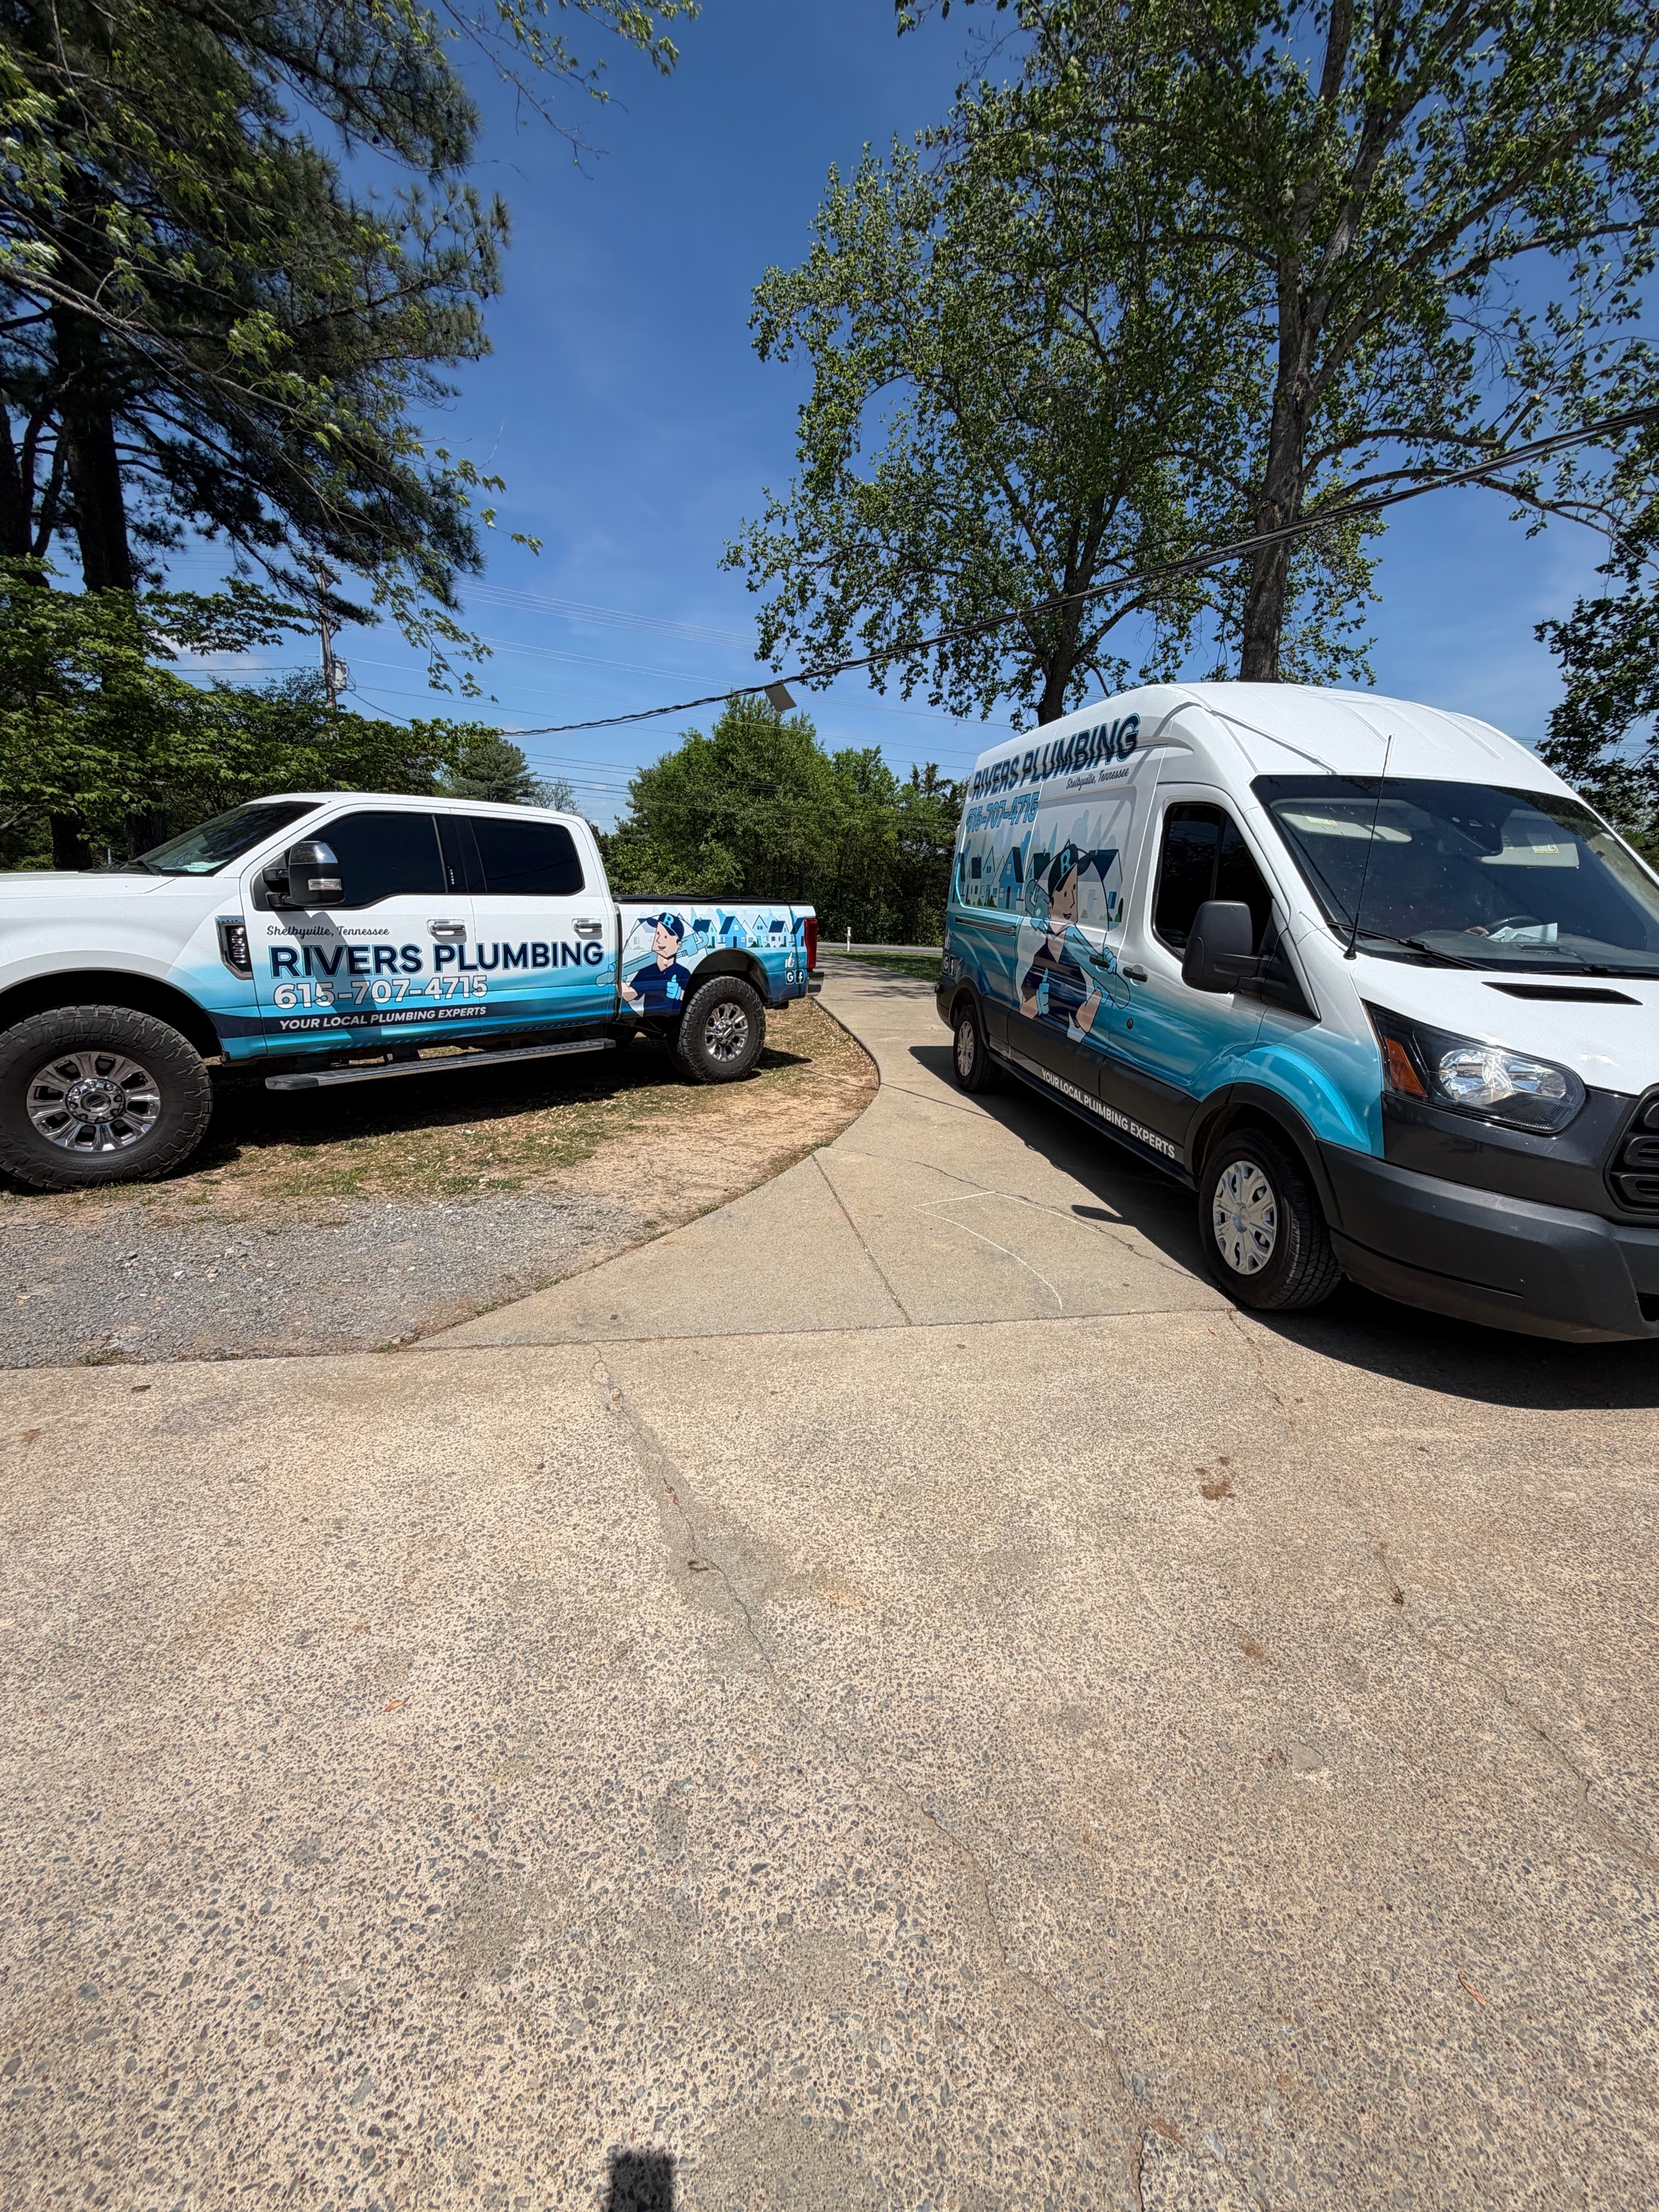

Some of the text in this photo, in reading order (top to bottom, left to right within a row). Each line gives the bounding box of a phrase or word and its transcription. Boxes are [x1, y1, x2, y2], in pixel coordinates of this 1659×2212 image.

[971, 712, 1141, 801] RIVERS PLUMBING
[1065, 768, 1130, 791] Shelbyville, Tennessee
[966, 791, 1040, 833] 615-707-4715
[266, 925, 390, 939] Shelbyville, Tennessee
[268, 941, 605, 979] RIVERS PLUMBING
[273, 975, 488, 1009] 615-707-4715
[279, 1006, 487, 1030] YOUR LOCAL PLUMBING EXPERTS
[1041, 1068, 1175, 1159] YOUR LOCAL PLUMBING EXPERTS
